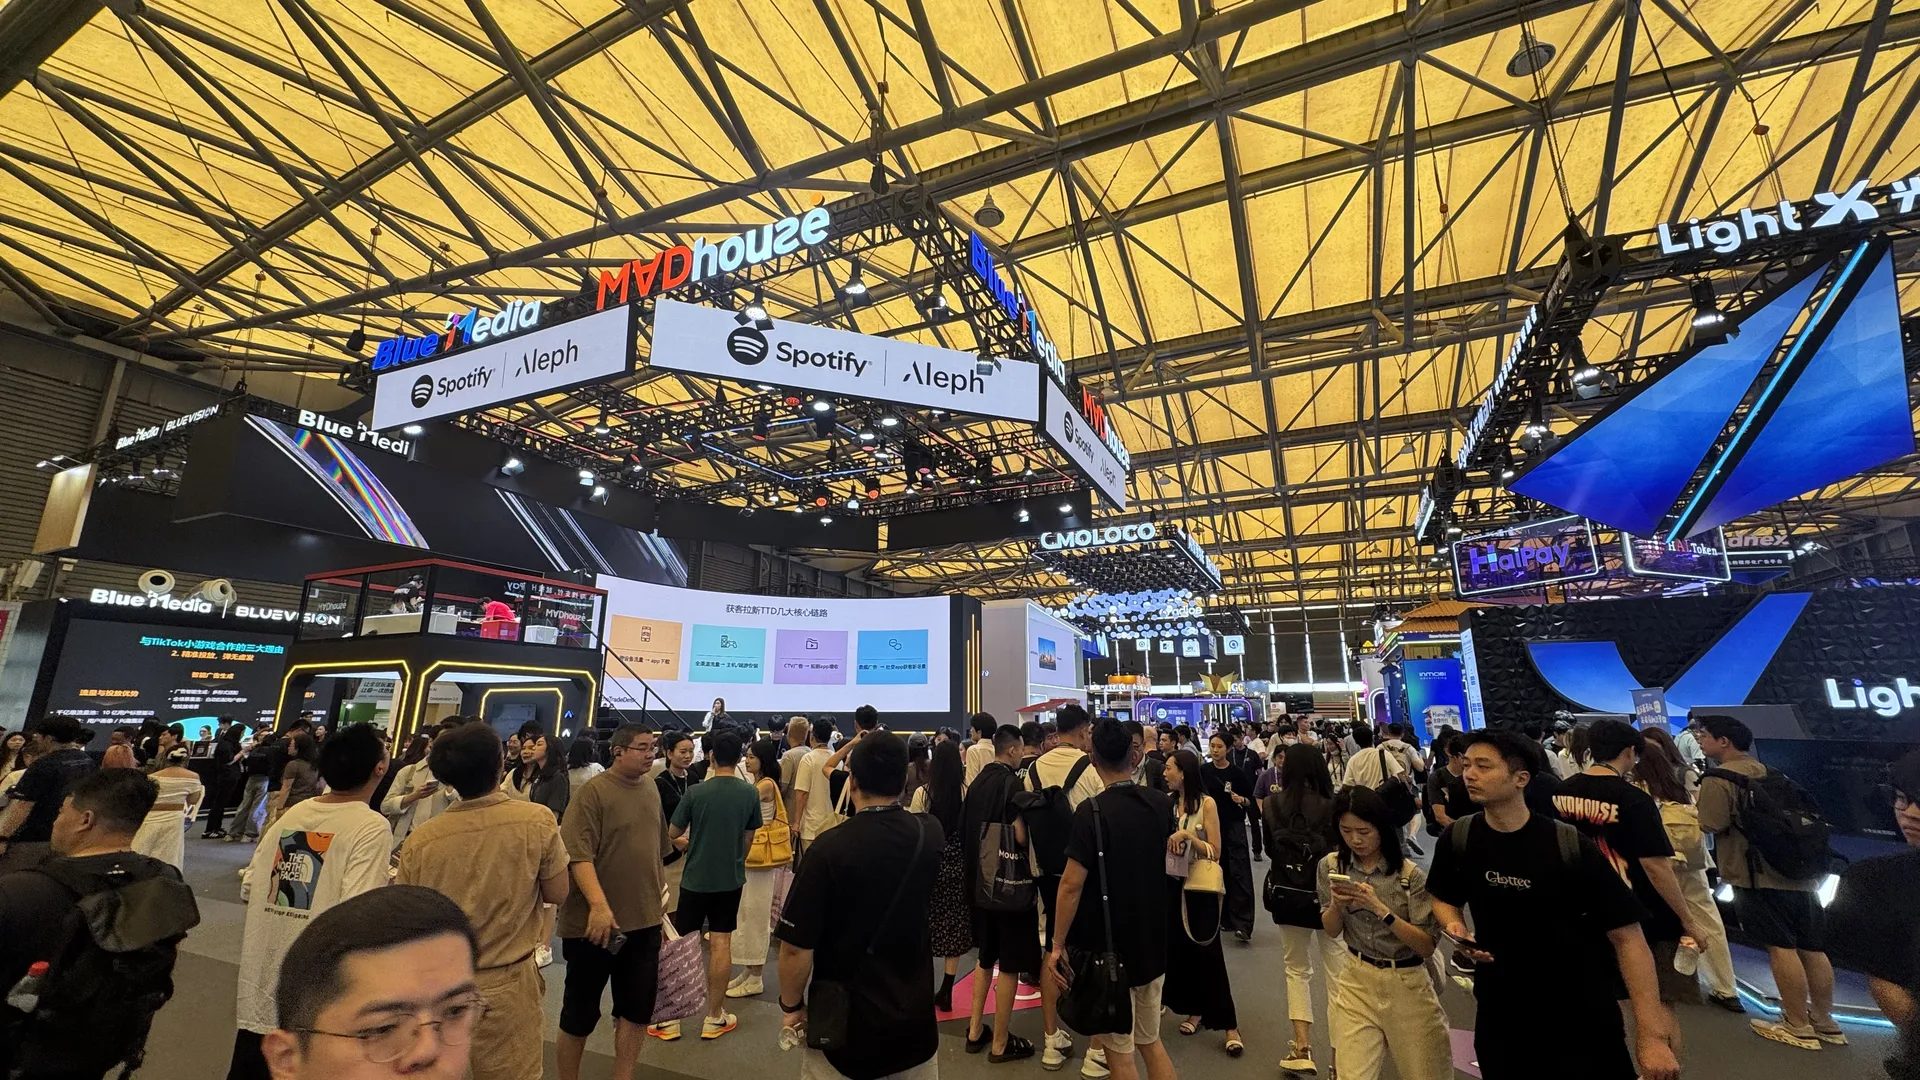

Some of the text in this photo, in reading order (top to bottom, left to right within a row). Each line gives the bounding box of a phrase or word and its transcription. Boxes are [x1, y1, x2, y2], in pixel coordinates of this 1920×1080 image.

[971, 230, 1018, 320] Blue
[372, 299, 541, 370] Blue Media
[437, 339, 578, 397] Spotify Aleph
[776, 341, 985, 395] Spotify Aleph
[165, 404, 219, 432] BLUEVISION
[298, 409, 354, 438] Blue
[1074, 428, 1095, 464] Spotify
[1469, 543, 1570, 575] HaiPay
[90, 588, 145, 606] Blue
[148, 590, 212, 613] Media
[726, 604, 828, 618] 获客拉新TTD几大核心链路
[140, 636, 285, 654] 与TikTok小游戏合作的三大理由
[289, 853, 305, 862] THE
[280, 871, 301, 881] FACE
